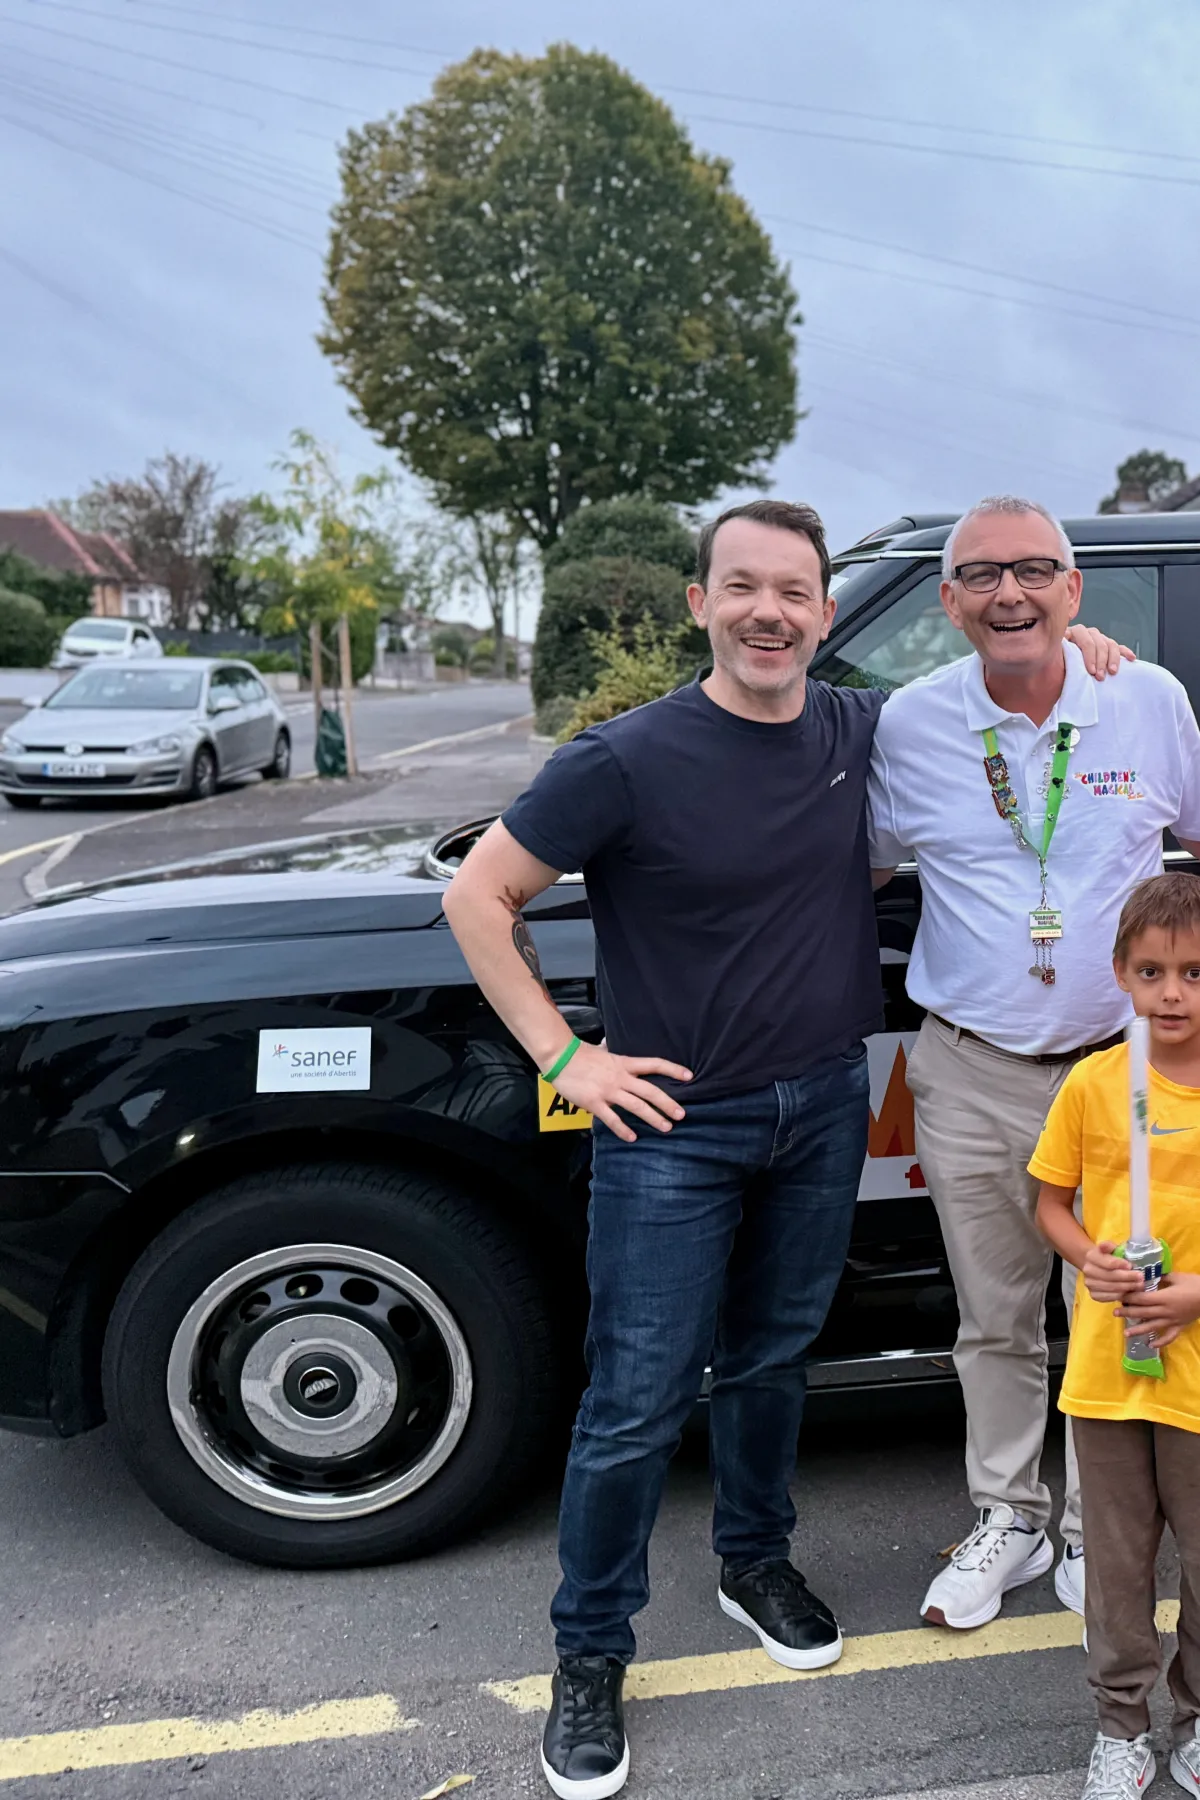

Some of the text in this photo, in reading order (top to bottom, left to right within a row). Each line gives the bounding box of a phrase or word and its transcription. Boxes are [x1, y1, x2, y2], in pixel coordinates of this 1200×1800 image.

[1093, 784, 1134, 796] MAGICAL
[290, 1050, 357, 1067] sanef
[328, 1069, 357, 1077] d'Abertis
